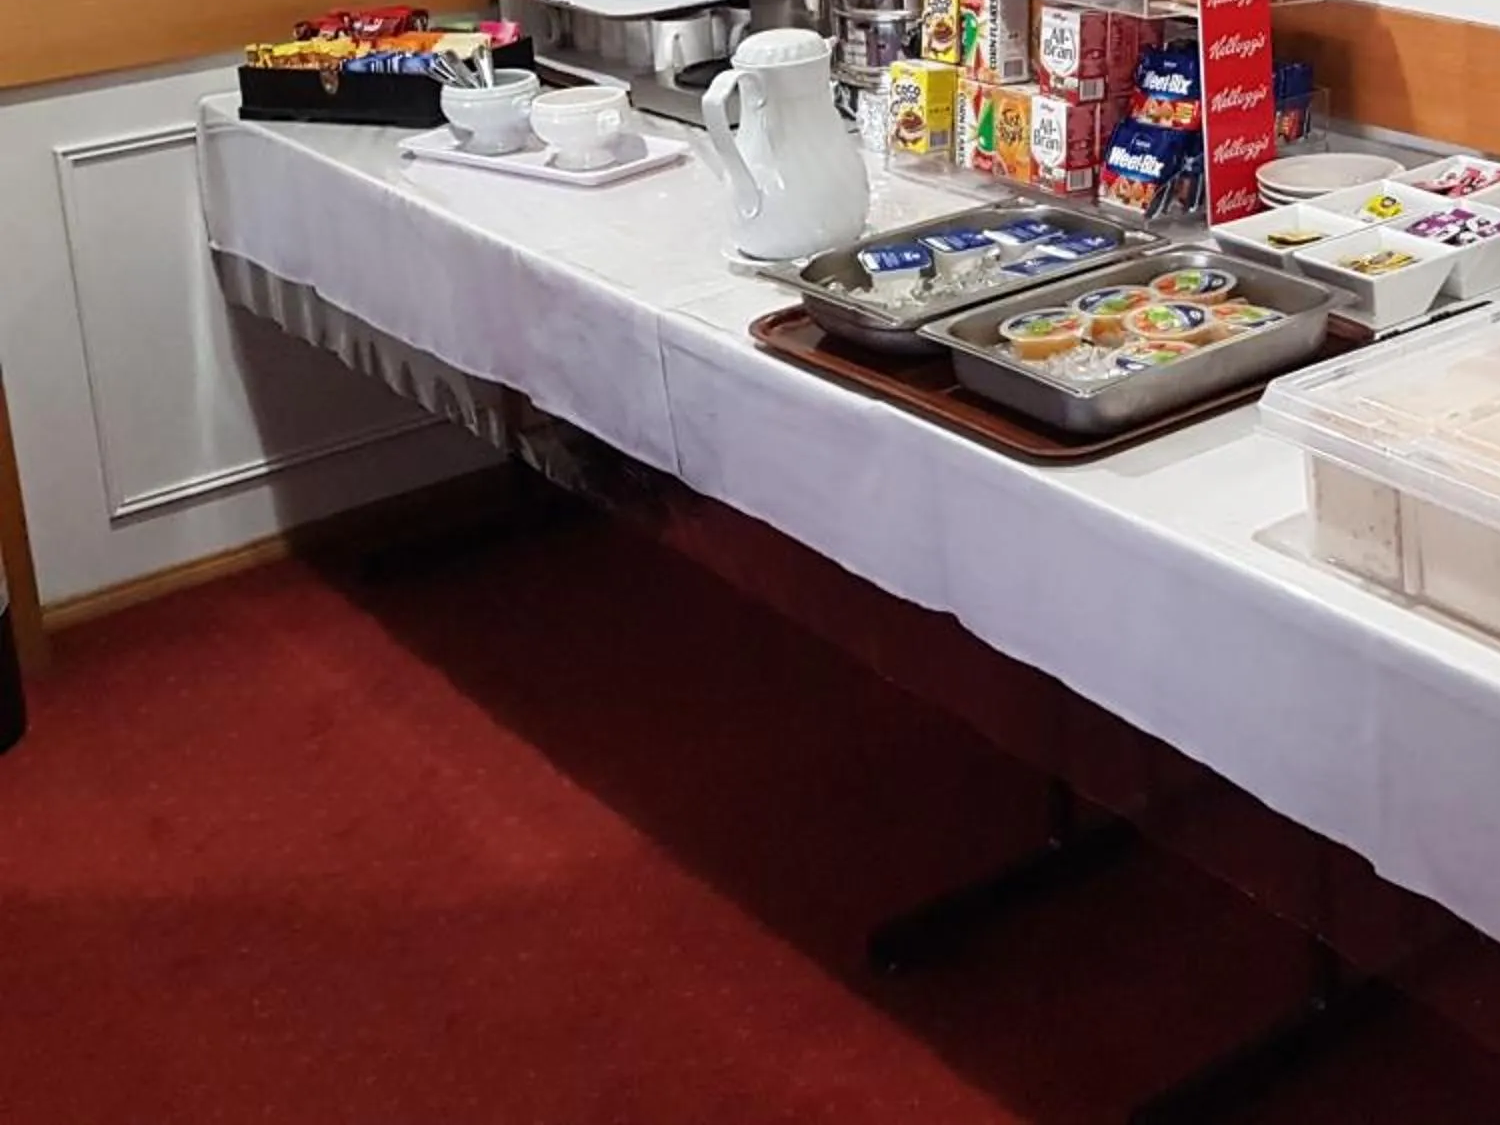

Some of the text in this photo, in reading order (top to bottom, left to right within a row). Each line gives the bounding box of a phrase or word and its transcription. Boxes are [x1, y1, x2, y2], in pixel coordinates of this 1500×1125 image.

[1044, 39, 1073, 61] Bran
[1208, 30, 1265, 60] Kellogg's
[1211, 83, 1268, 113] Kellogg's
[1033, 130, 1060, 151] Bran
[1213, 133, 1270, 164] Kellogg's
[1108, 145, 1164, 178] Weet-Bix
[1216, 187, 1256, 215] Kellog
